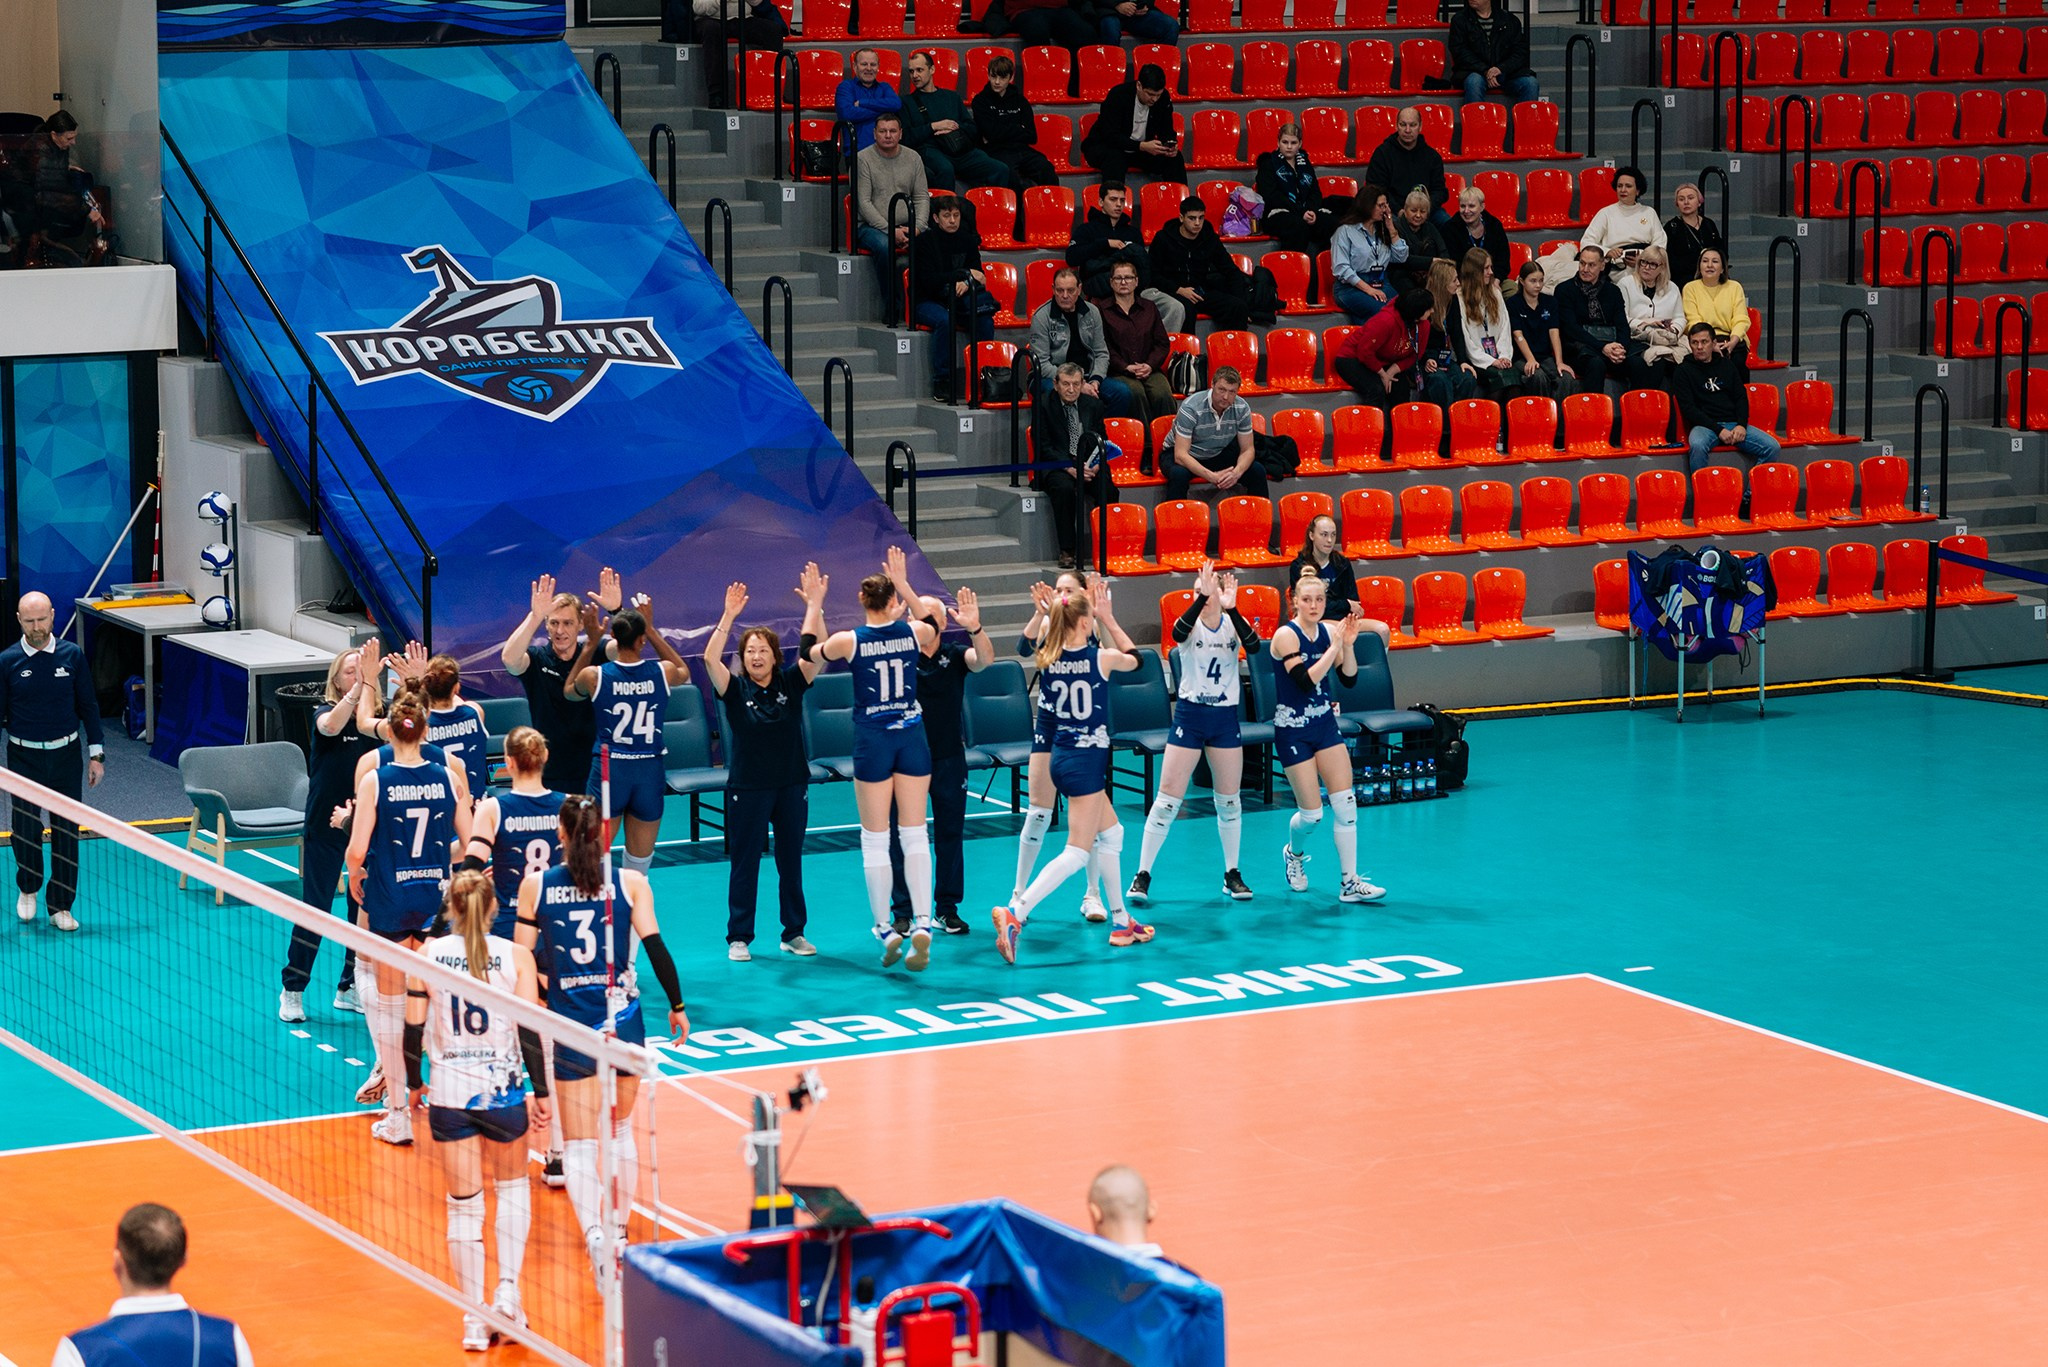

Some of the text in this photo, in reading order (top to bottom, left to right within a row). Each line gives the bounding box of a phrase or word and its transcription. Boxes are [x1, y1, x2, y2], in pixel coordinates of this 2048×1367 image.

[345, 326, 659, 372] КОРАБЕЛКА
[438, 357, 589, 373] САНКТ-ПЕТЕРБУРГ
[860, 636, 914, 657] ПАЛЬШИНА
[1048, 659, 1091, 675] БОБРОВА
[1206, 657, 1222, 685] 4
[612, 679, 655, 696] МОРЕНО
[874, 658, 904, 702] 11
[1051, 679, 1092, 720] 20
[612, 700, 655, 745] 24
[1175, 726, 1184, 738] 4
[387, 783, 446, 802] ЗАХАРОВА
[406, 807, 430, 858] 7
[504, 814, 560, 833] ФИЛИППО
[524, 838, 551, 877] 8
[546, 883, 616, 905] НЕСТЕВА
[568, 909, 597, 965] 3
[435, 955, 502, 972] МУРАВА
